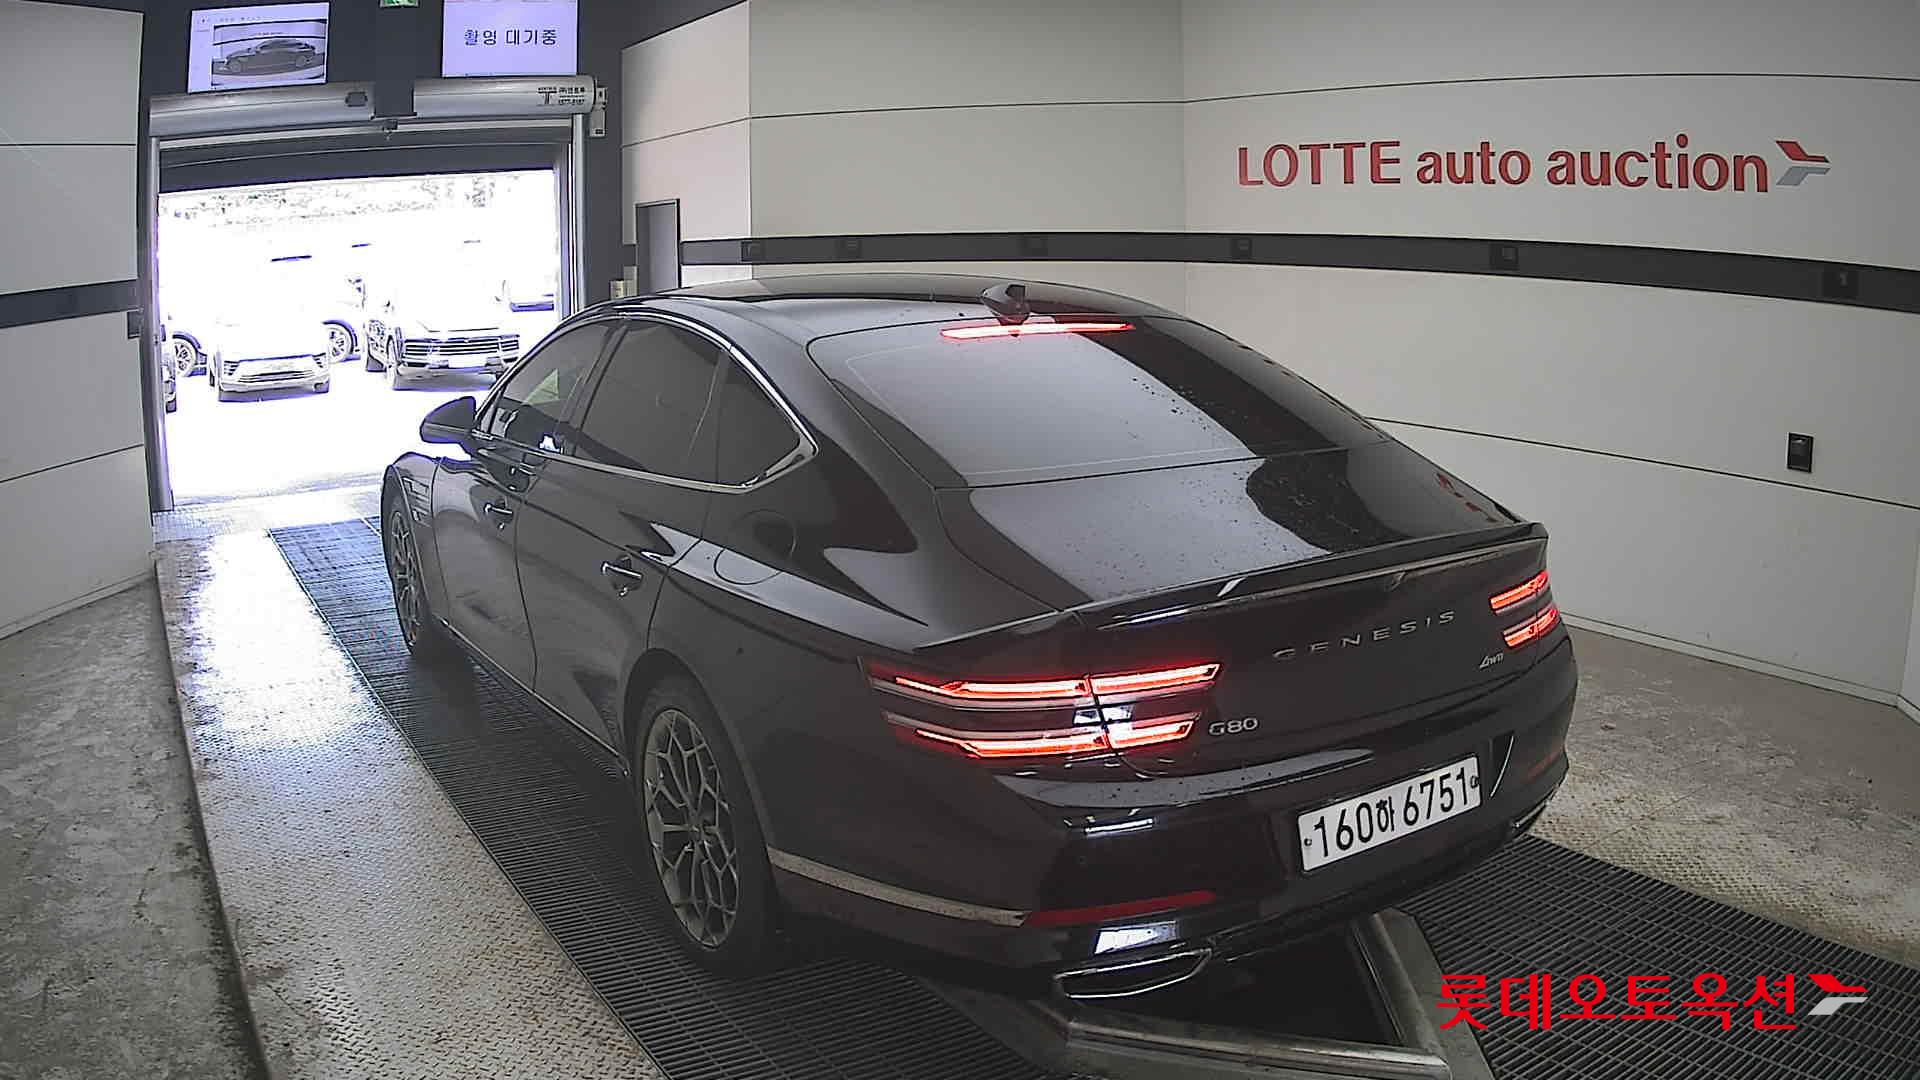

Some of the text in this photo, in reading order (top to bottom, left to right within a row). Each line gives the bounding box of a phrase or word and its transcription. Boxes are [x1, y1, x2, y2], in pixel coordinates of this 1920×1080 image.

[505, 29, 557, 46] 대기중
[1238, 133, 1768, 193] LOTTE auto auction
[1273, 609, 1456, 659] GENESIS
[1208, 717, 1258, 736] G80
[1402, 766, 1468, 827] 6751
